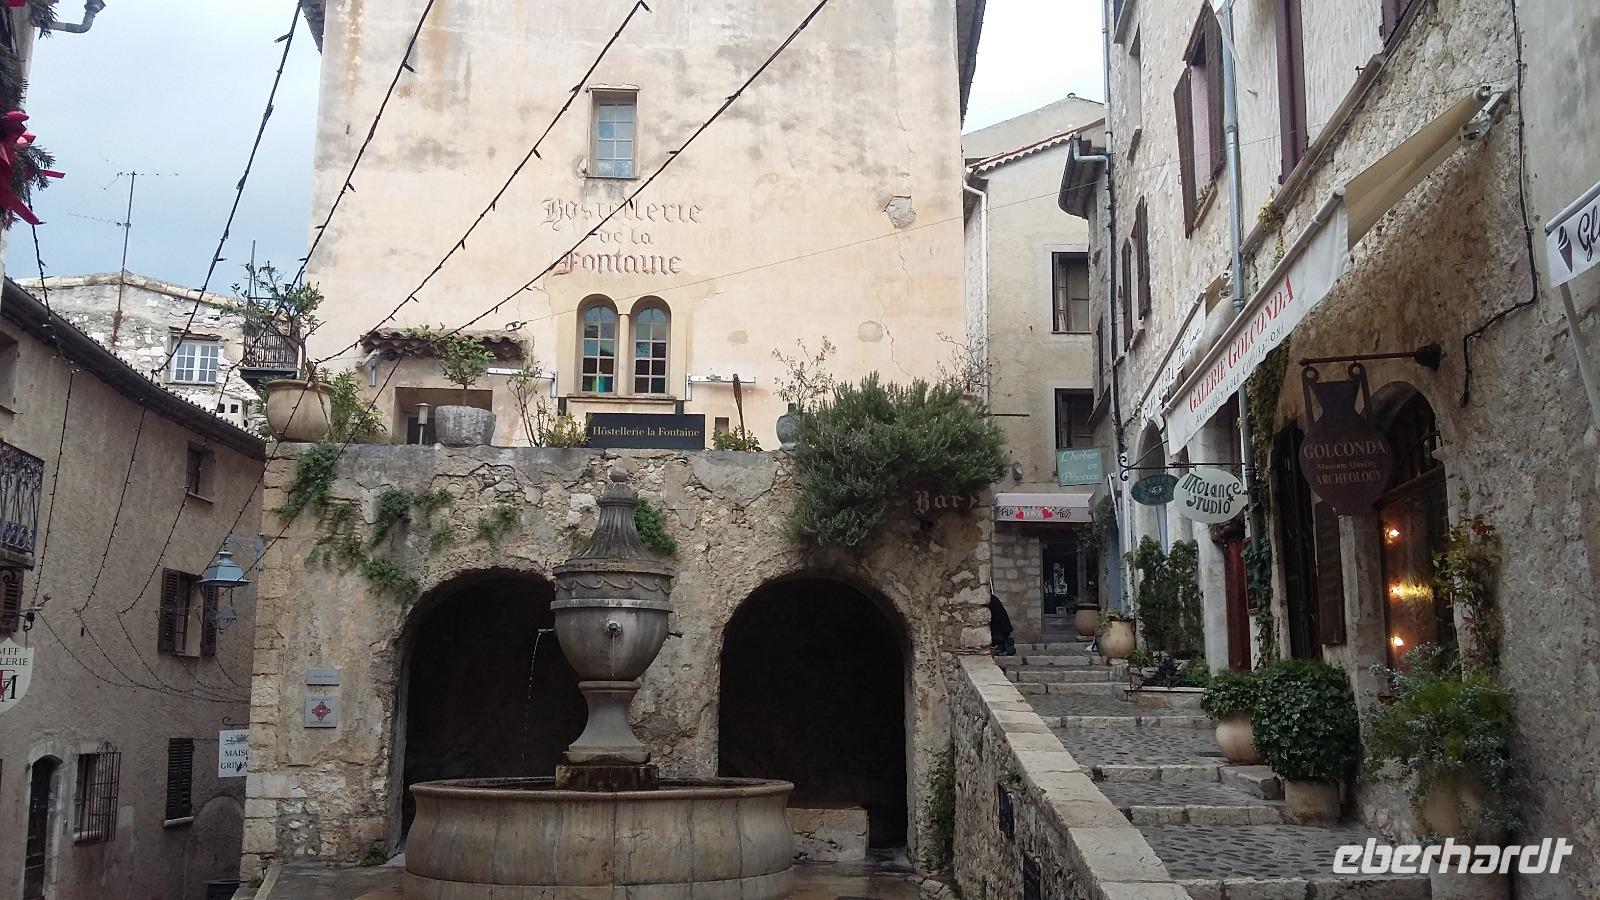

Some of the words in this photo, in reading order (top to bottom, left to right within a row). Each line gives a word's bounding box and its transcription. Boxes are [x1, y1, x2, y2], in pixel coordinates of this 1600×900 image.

[630, 228, 653, 245] la
[1577, 204, 1600, 262] Gl
[552, 249, 683, 277] Fontaine
[1189, 357, 1226, 412] GALERIE
[1228, 272, 1294, 368] GOLCONDA
[593, 426, 645, 436] Hôstellerie
[647, 427, 655, 436] la
[658, 427, 700, 437] Fontaine
[1303, 441, 1386, 459] GOLCONDA
[912, 490, 965, 515] Bar
